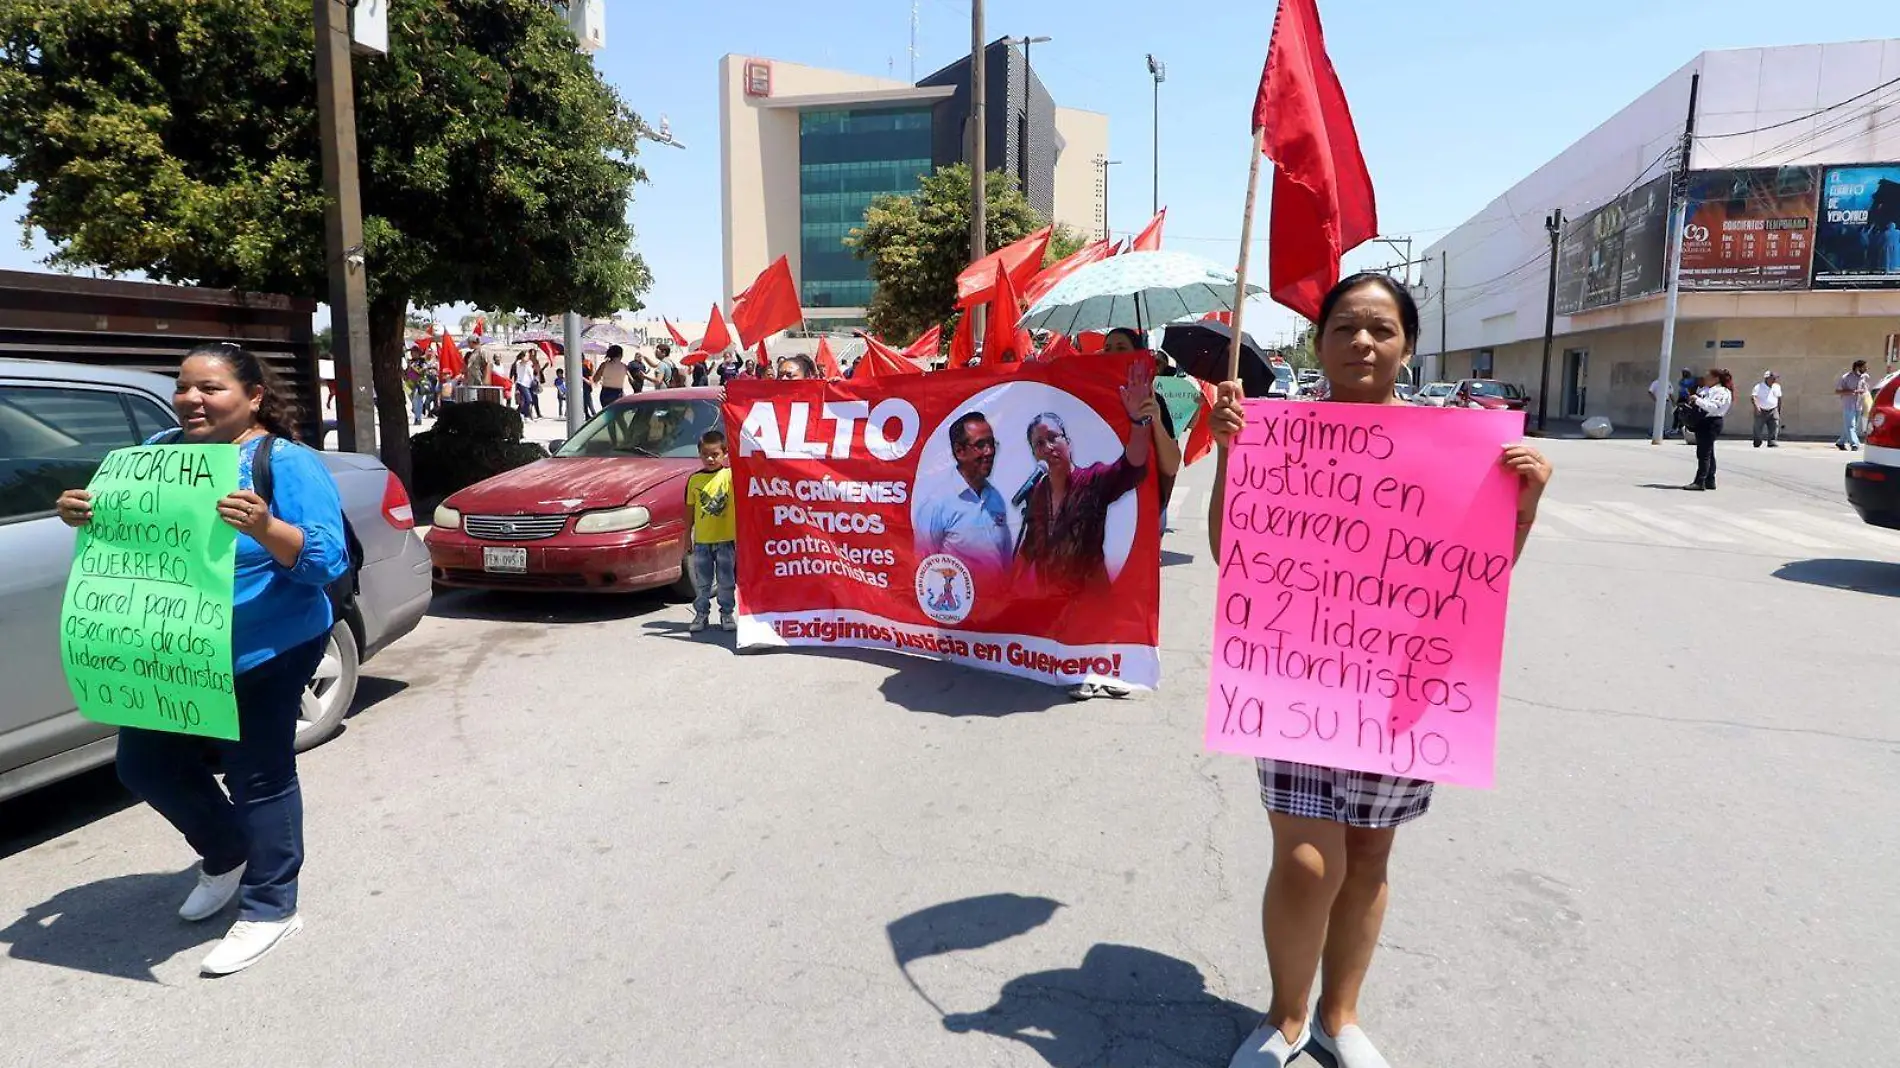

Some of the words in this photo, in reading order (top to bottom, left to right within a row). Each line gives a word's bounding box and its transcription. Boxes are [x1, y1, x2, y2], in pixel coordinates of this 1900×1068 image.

[739, 398, 919, 461] ALTO
[92, 449, 215, 488] ANTORCHA
[748, 477, 763, 497] A
[795, 474, 907, 504] CRÍMENES
[1232, 453, 1362, 506] Justicia
[1373, 477, 1425, 517] en
[92, 489, 131, 523] xige
[139, 484, 160, 514] al
[773, 505, 886, 534] POLÍTICOS
[165, 521, 191, 552] de
[764, 535, 831, 556] contra
[1229, 491, 1370, 553] Guerrero
[1380, 528, 1508, 599] porque
[81, 544, 188, 584] GUERRERO
[775, 559, 888, 588] antorchistas
[1223, 540, 1467, 625] Asesinaron
[73, 580, 135, 616] Carcel
[142, 593, 188, 629] para
[195, 592, 224, 631] los
[65, 615, 144, 648] asecinos
[151, 619, 173, 655] de
[177, 626, 215, 657] dos
[1225, 593, 1251, 630] a
[1264, 591, 1292, 635] 2
[1311, 596, 1453, 665] lideres
[68, 641, 127, 673] lideres
[132, 653, 234, 695] antorchistas
[890, 626, 968, 657] justicia
[973, 642, 1002, 663] en
[1006, 641, 1122, 677] Guerrero!
[1223, 632, 1472, 713] antorchistas
[98, 684, 113, 704] a
[119, 684, 145, 710] su
[1279, 701, 1338, 741] su
